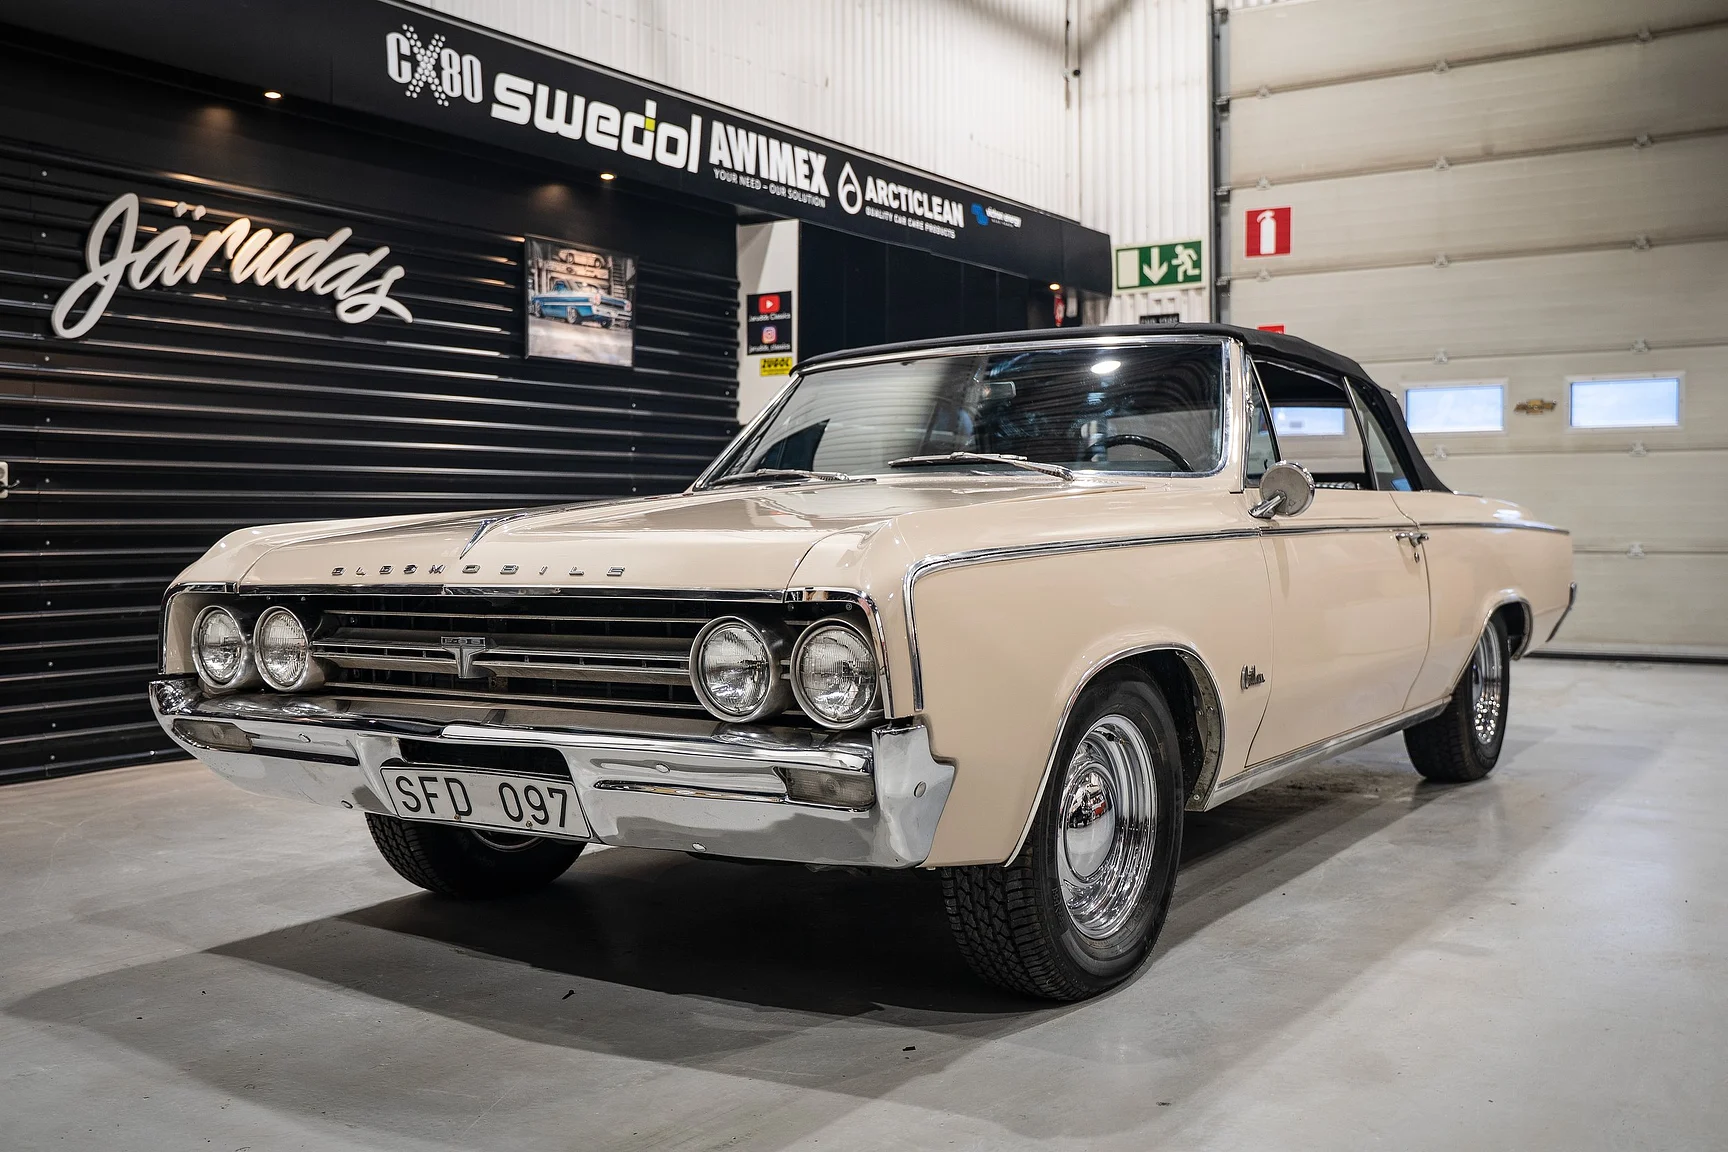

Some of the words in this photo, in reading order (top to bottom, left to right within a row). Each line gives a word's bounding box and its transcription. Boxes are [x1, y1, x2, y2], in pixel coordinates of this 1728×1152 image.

[386, 24, 483, 107] CX80
[490, 73, 702, 174] swedol
[709, 120, 830, 197] AWIMEX
[713, 167, 738, 184] YOUR
[739, 176, 762, 190] NEED
[769, 183, 786, 197] OUR
[787, 188, 826, 208] SOLUTION
[865, 175, 965, 228] ARCTICLEAN
[865, 206, 893, 222] QUALITY
[893, 213, 907, 226] CAR
[907, 217, 924, 231] CARE
[924, 222, 956, 239] PRODUCTS
[51, 193, 413, 339] Järudds
[331, 564, 626, 577] OLDSMOBILE
[395, 775, 472, 817] SFD
[498, 782, 568, 828] 097
